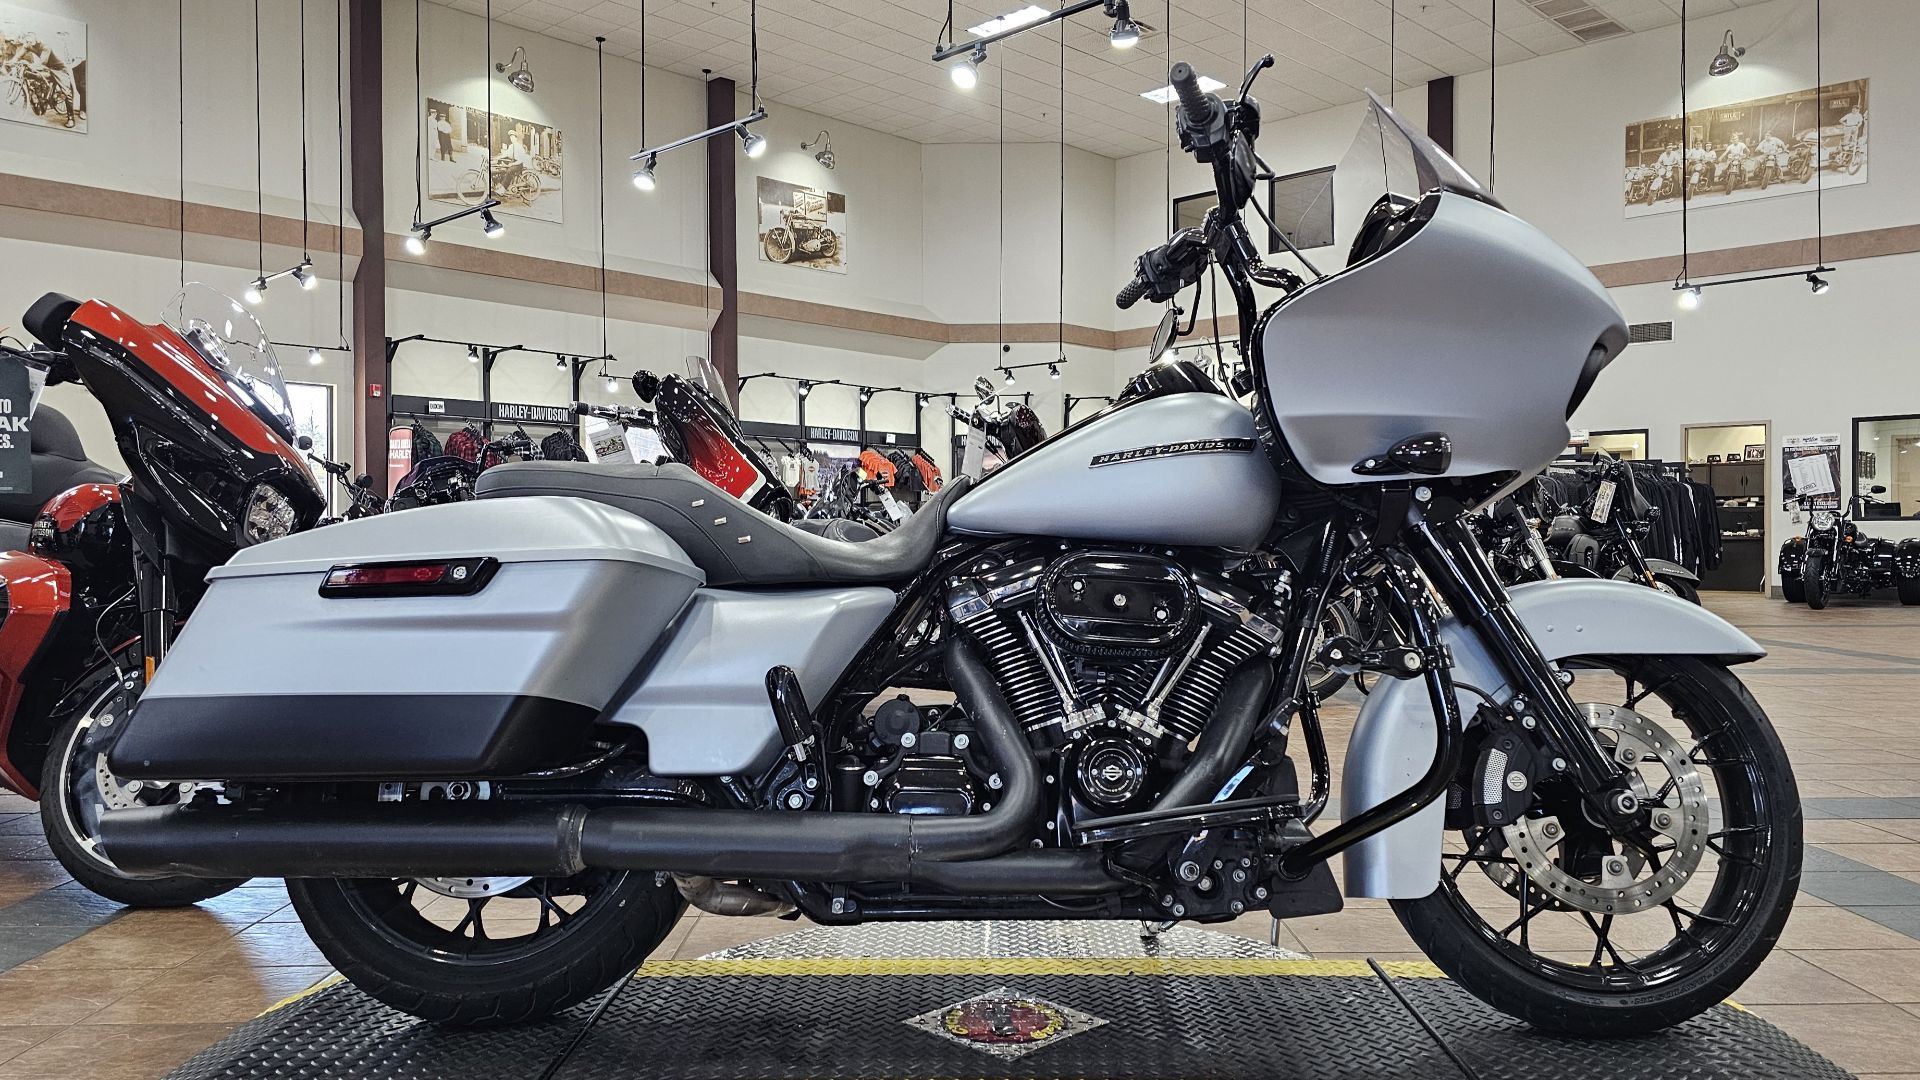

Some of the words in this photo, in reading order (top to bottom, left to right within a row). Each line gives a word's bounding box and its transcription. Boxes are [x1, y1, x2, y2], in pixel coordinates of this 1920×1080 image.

[498, 403, 569, 423] HARLEY-DAVIDSON
[810, 427, 859, 441] HARLEY-DAVIDSON
[1099, 440, 1256, 463] HARLEY-DAVIDSON
